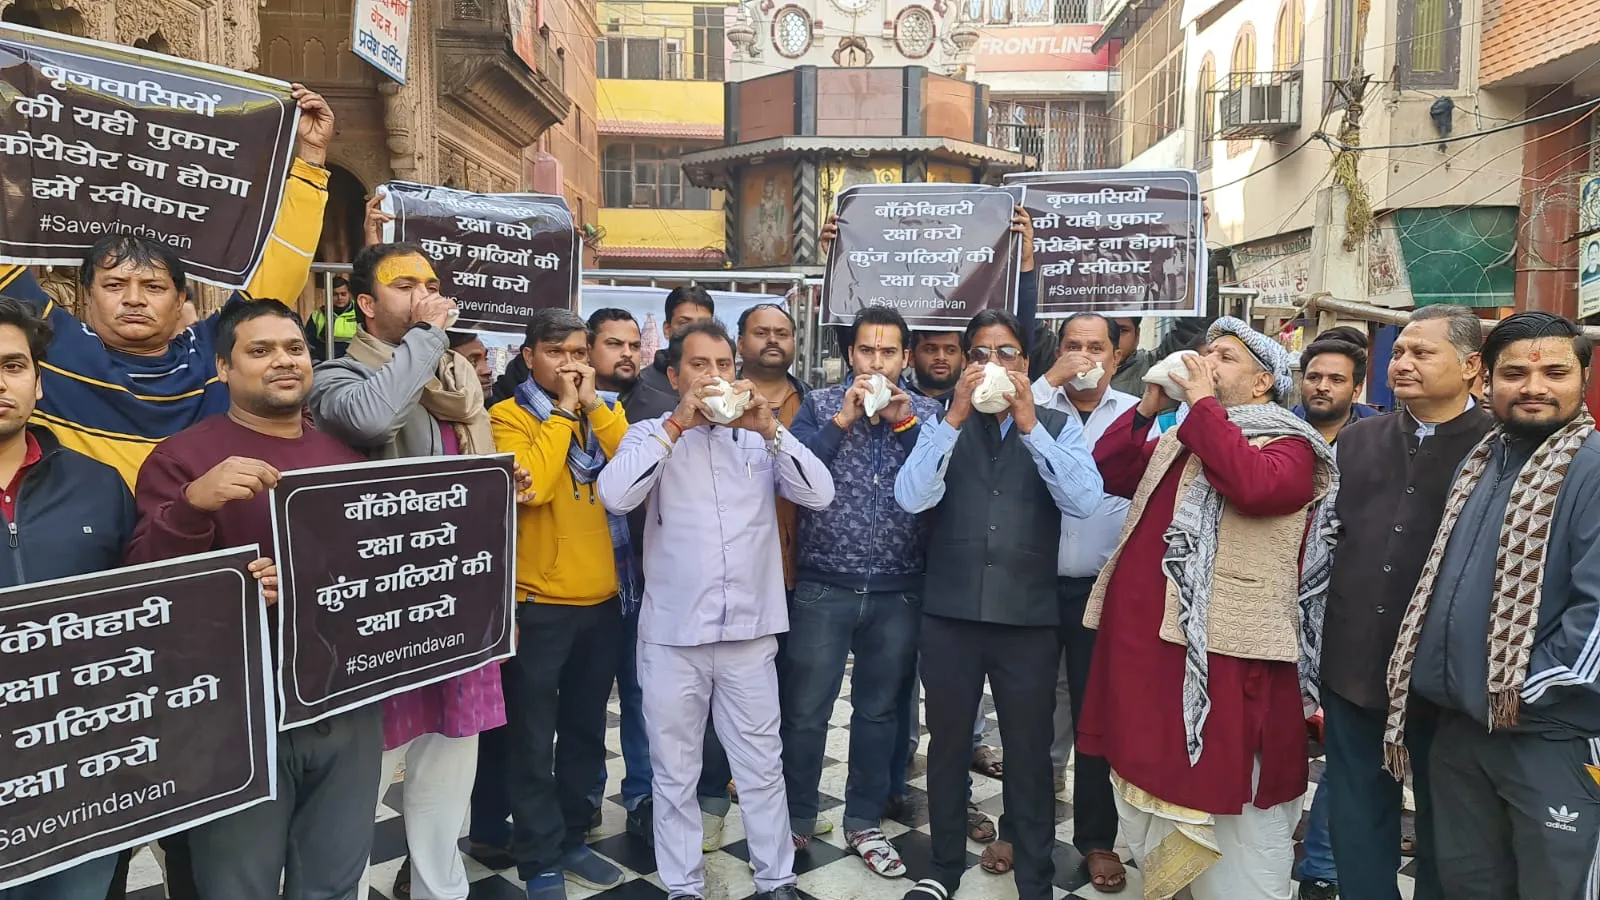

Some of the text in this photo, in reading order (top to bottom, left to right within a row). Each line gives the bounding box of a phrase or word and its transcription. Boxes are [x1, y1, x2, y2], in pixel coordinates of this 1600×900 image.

[359, 29, 402, 73] प्रवेश वर्जित
[978, 35, 1096, 56] FRONTLINE
[39, 61, 222, 118] बृजवासियों
[15, 93, 241, 159] की यही पुकार
[127, 153, 170, 180] ना
[176, 163, 253, 198] होगा
[31, 175, 210, 223] हमें स्वीकार
[874, 199, 975, 218] बाँकेबिहारी
[1046, 185, 1150, 209] बृजवासियों
[39, 214, 193, 249] #Savevrindavan
[455, 215, 532, 241] रक्षा करो
[882, 223, 963, 241] रक्षा करो
[1032, 210, 1164, 231] की यही पुकार
[420, 236, 560, 271] कुंज गलियों की
[849, 246, 996, 268] कुंज गलियों की
[1098, 237, 1123, 250] ना
[1128, 233, 1176, 249] होगा
[452, 271, 531, 293] रक्षा करो
[880, 272, 960, 287] रक्षा करो
[1041, 258, 1152, 277] हमें स्वीकार
[446, 296, 534, 317] avevrindavan
[868, 296, 966, 310] #Savevrindavan
[1048, 283, 1145, 296] #Savevrindavan
[343, 483, 468, 520] बाँकेबिहारी
[357, 522, 458, 559] रक्षा करो
[316, 551, 493, 612] कुंज गलियों की
[0, 596, 173, 653] केबिहारी
[356, 594, 457, 637] रक्षा करो
[71, 646, 155, 686] करो
[346, 632, 465, 676] #Savevrindavan
[12, 674, 221, 749] गलियों की
[78, 736, 160, 779] करो
[1545, 821, 1577, 832] adidas
